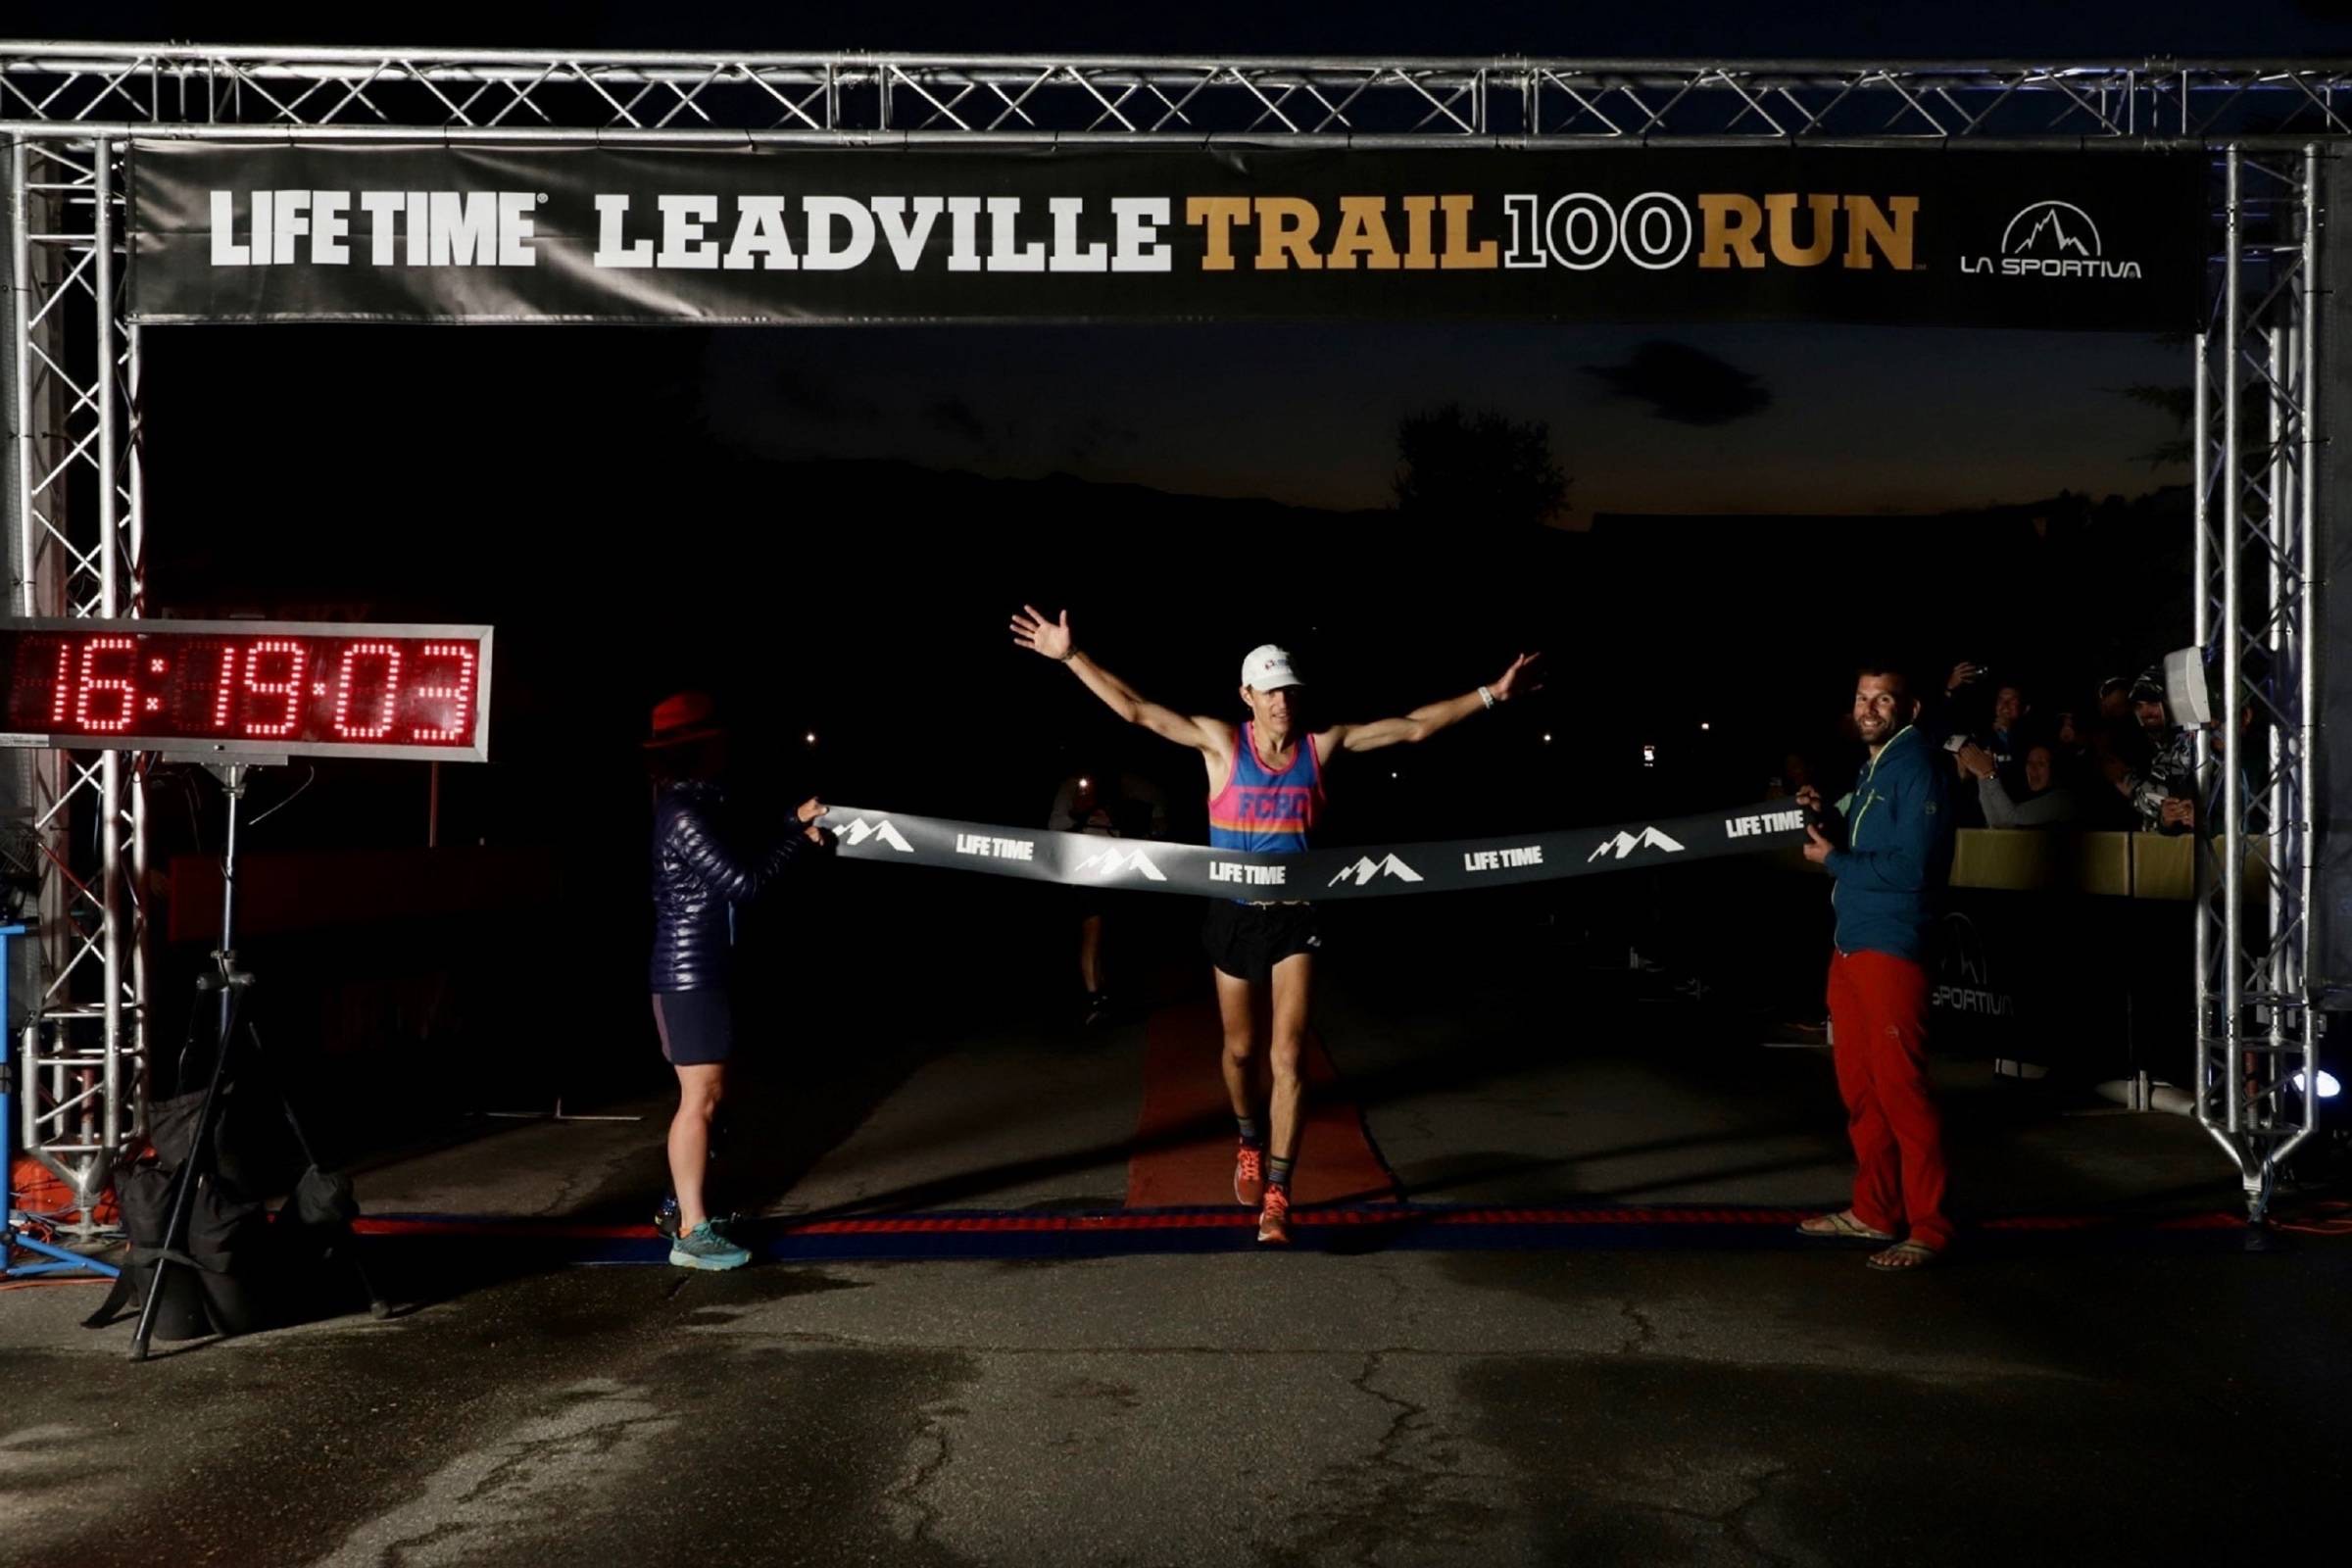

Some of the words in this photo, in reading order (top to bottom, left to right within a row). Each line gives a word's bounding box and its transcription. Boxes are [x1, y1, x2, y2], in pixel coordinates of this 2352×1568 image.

[211, 189, 350, 266] LIFE
[594, 194, 1172, 272] LEADVILLE
[1186, 196, 1498, 270] TRAIL
[1961, 256, 1994, 274] LA
[2000, 258, 2142, 279] SPORTIVA
[1725, 815, 1762, 839] LIFE
[1761, 808, 1805, 833] TIME
[956, 833, 992, 857] LIFE
[992, 837, 1035, 861] TIME
[1464, 851, 1500, 872] LIFE
[1498, 845, 1544, 868] TIME
[1209, 860, 1243, 883] LIFE
[1244, 864, 1287, 885] TIME
